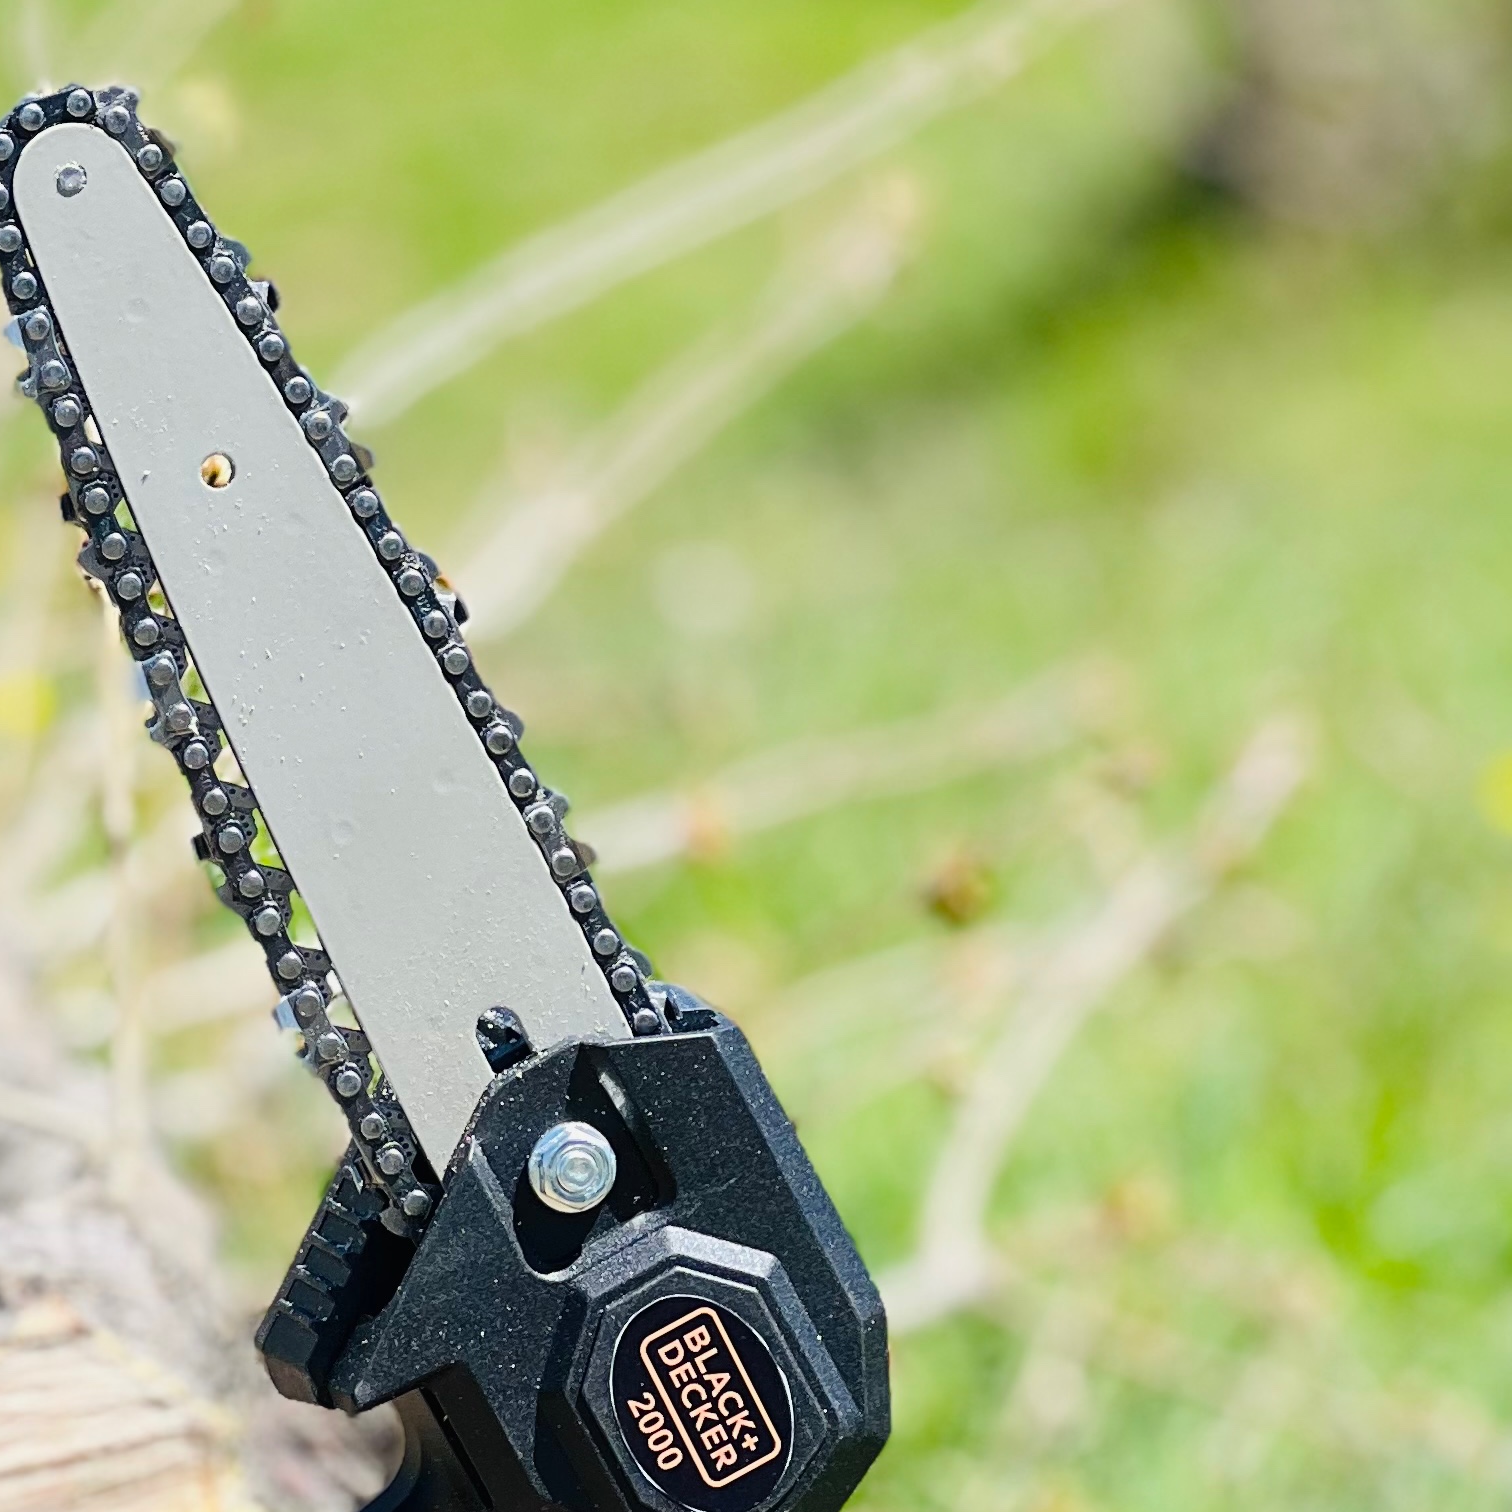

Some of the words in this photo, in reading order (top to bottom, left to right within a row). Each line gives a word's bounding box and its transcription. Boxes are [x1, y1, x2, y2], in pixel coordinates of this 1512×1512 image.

[627, 1391, 684, 1471] 2000
[657, 1338, 738, 1472] DECKER
[682, 1324, 759, 1452] BLACK+
